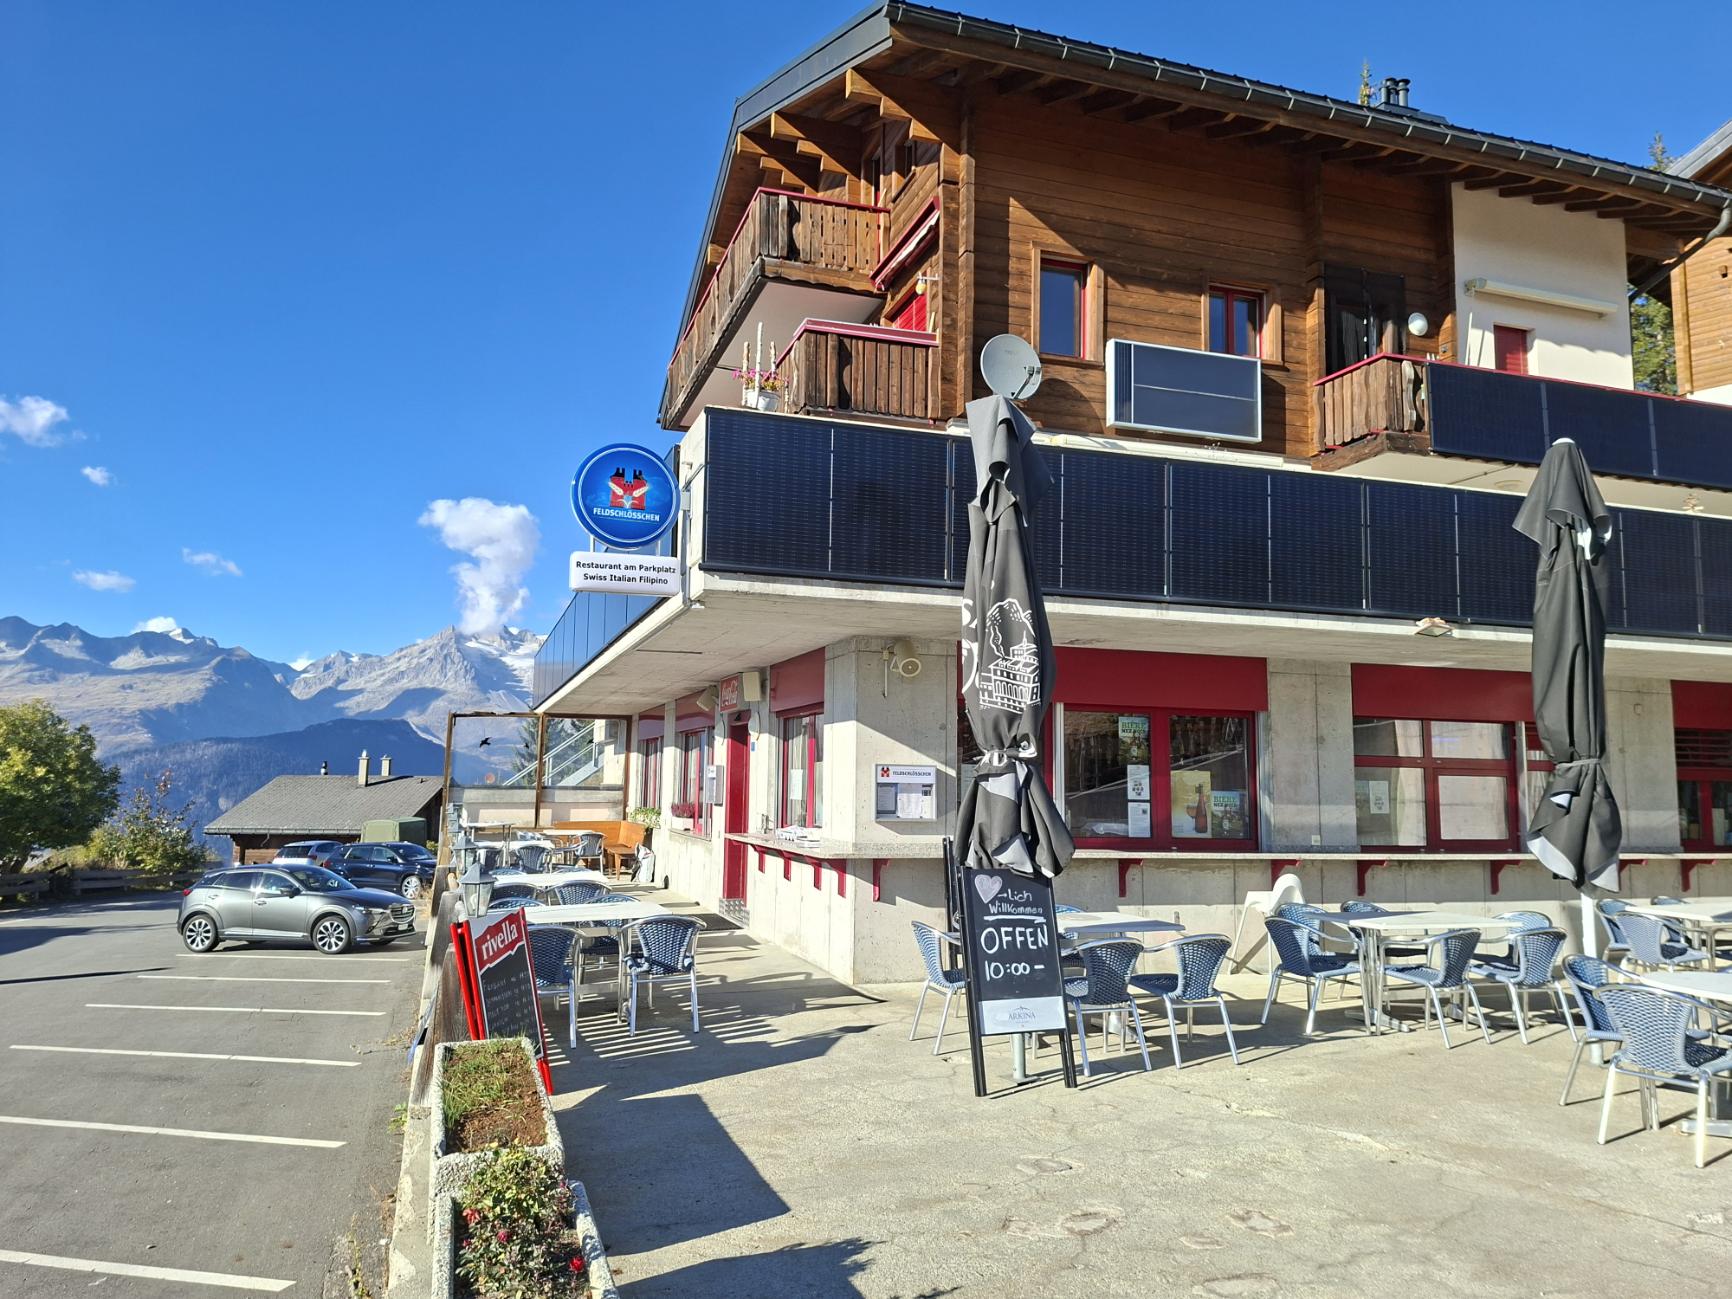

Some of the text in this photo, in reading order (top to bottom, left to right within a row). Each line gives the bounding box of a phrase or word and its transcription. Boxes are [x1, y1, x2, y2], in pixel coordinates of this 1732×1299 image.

[593, 507, 660, 522] FELDSCHLÖSSCHEN
[576, 561, 622, 571] Restaurant
[639, 564, 676, 574] Parkplatz
[583, 573, 669, 585] Swiss Italian Filipino
[480, 920, 518, 962] rivella
[981, 924, 1049, 954] OFFEN
